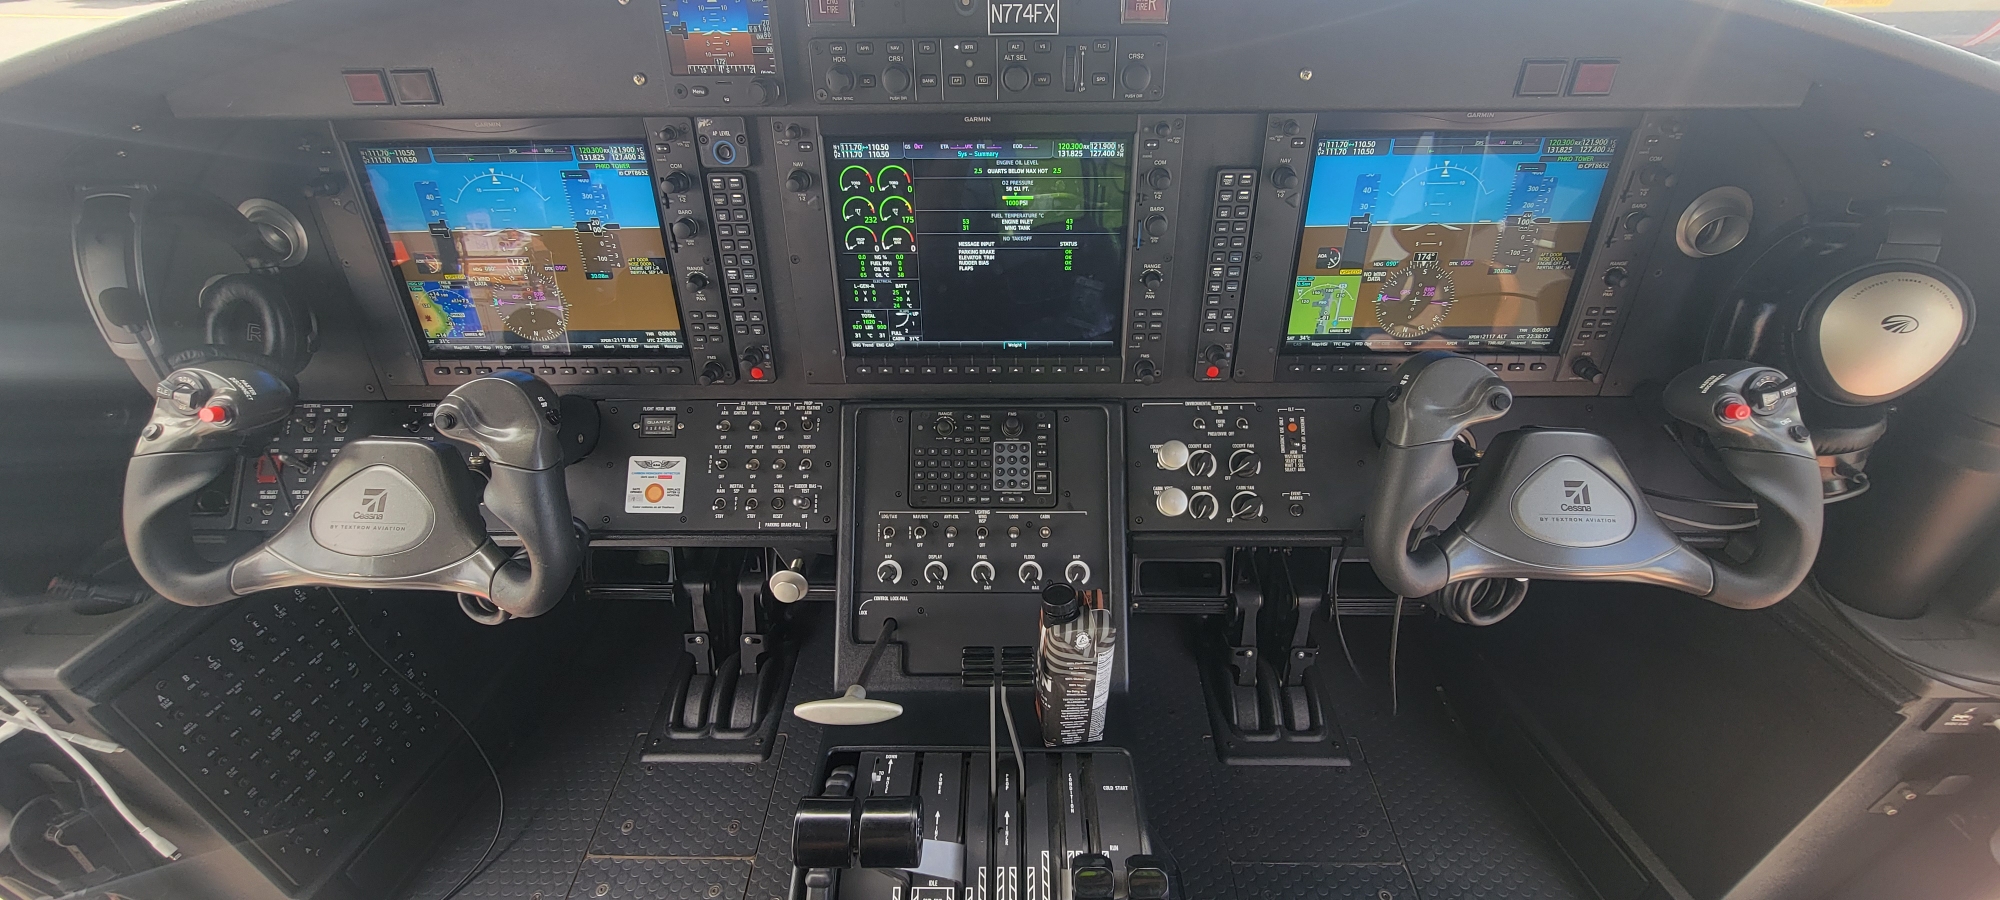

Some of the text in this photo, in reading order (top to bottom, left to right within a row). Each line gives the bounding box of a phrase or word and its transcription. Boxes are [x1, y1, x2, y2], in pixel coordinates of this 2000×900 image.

[1136, 2, 1148, 11] FIRE
[991, 3, 1054, 24] N774FX
[1781, 386, 1796, 396] TRIM
[353, 511, 383, 520] Cessna
